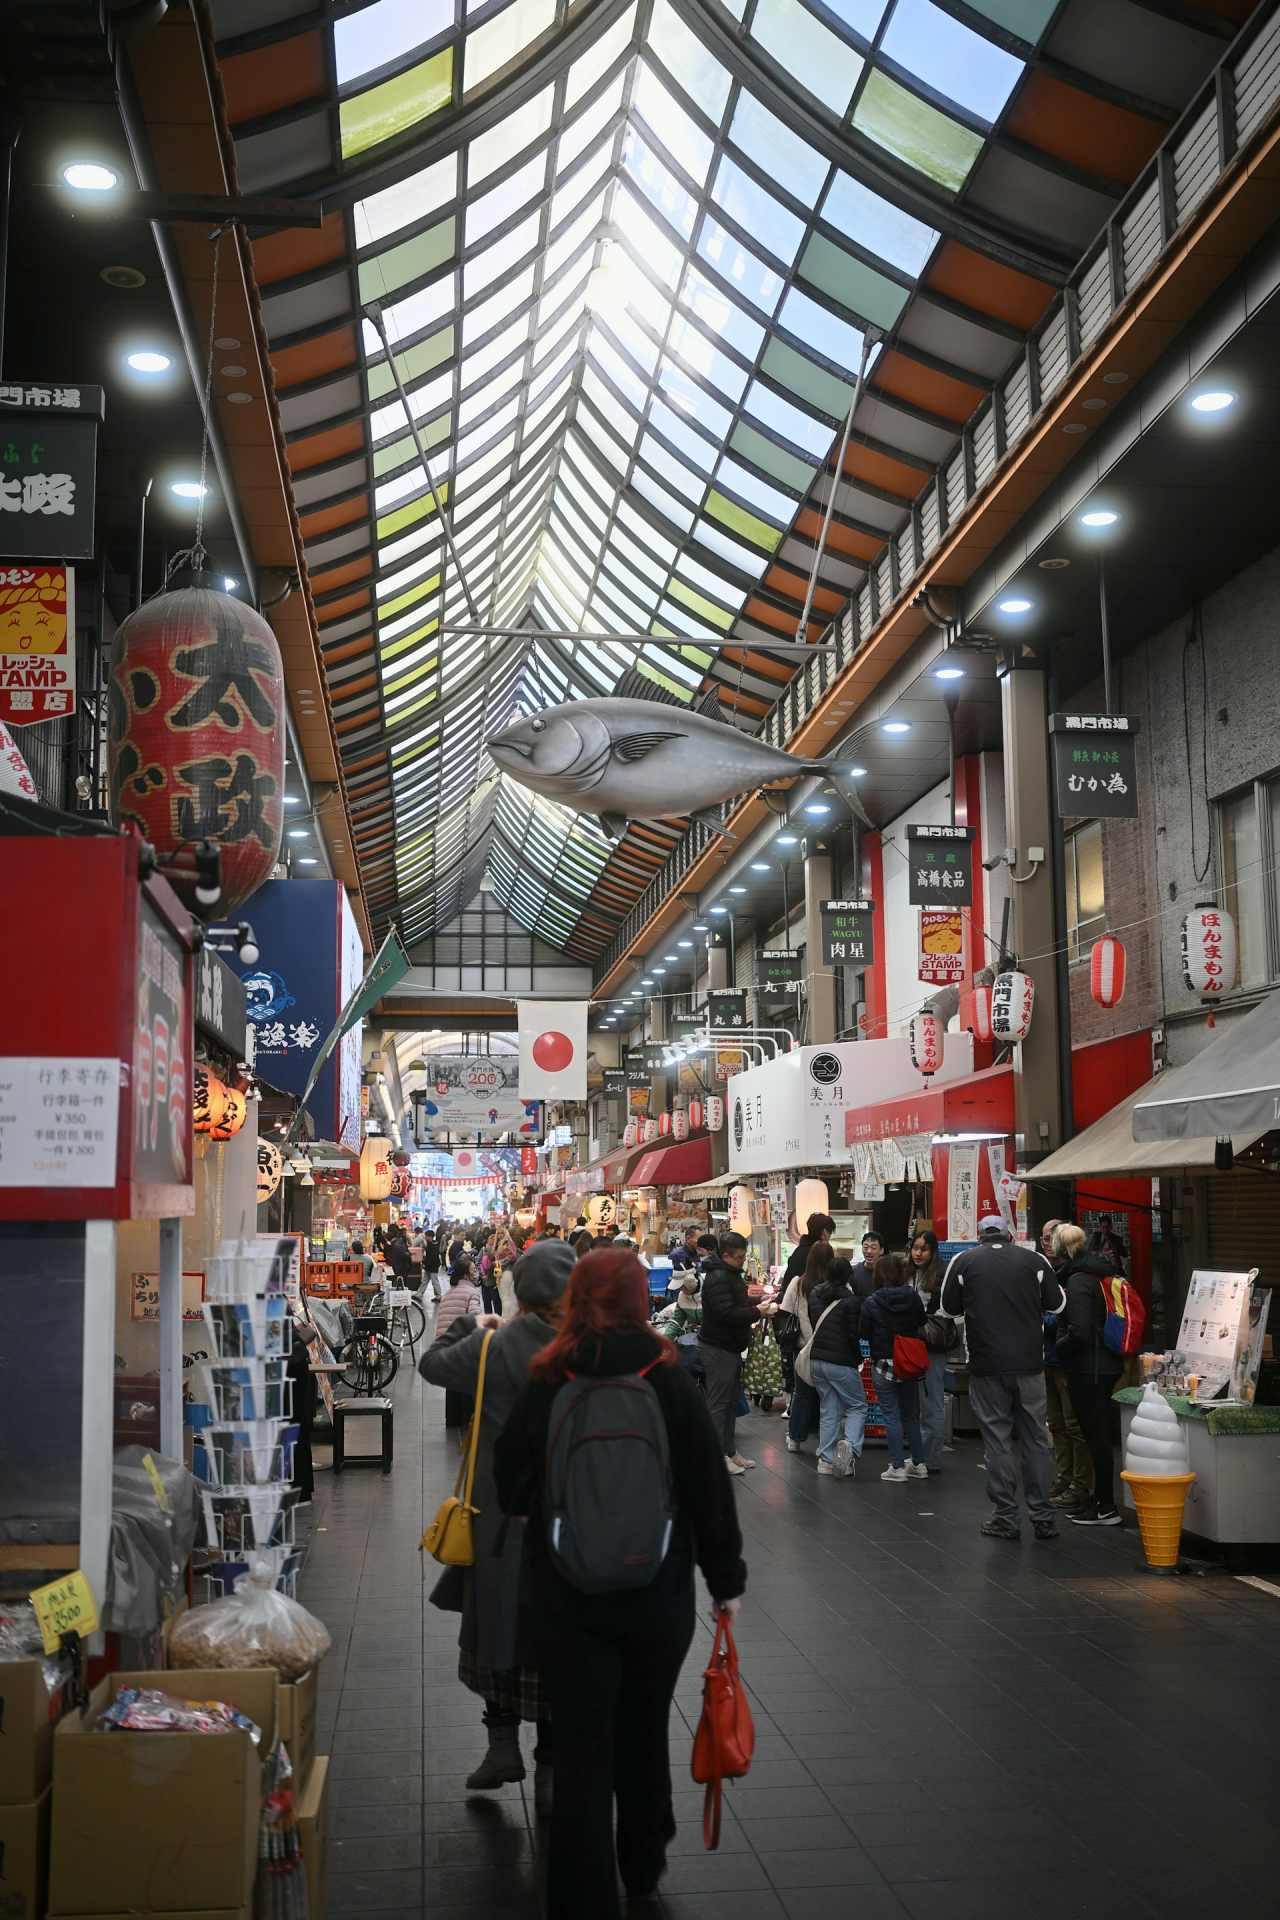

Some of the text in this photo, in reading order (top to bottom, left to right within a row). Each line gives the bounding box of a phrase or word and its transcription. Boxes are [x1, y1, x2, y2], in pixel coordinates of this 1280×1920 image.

[1065, 716, 1129, 729] 黒門市場
[916, 826, 967, 838] 黒門市場
[827, 901, 869, 910] 黒門市場
[831, 930, 863, 938] WAGYU
[831, 943, 864, 958] 肉星
[1201, 913, 1223, 992] ほんまもん
[921, 960, 962, 969] STAMP
[993, 974, 1013, 1033] 黒門市場
[923, 1017, 936, 1067] ほんまもん
[468, 1073, 497, 1085] 200
[810, 1086, 843, 1101] 美月
[600, 1199, 611, 1222] 寿し
